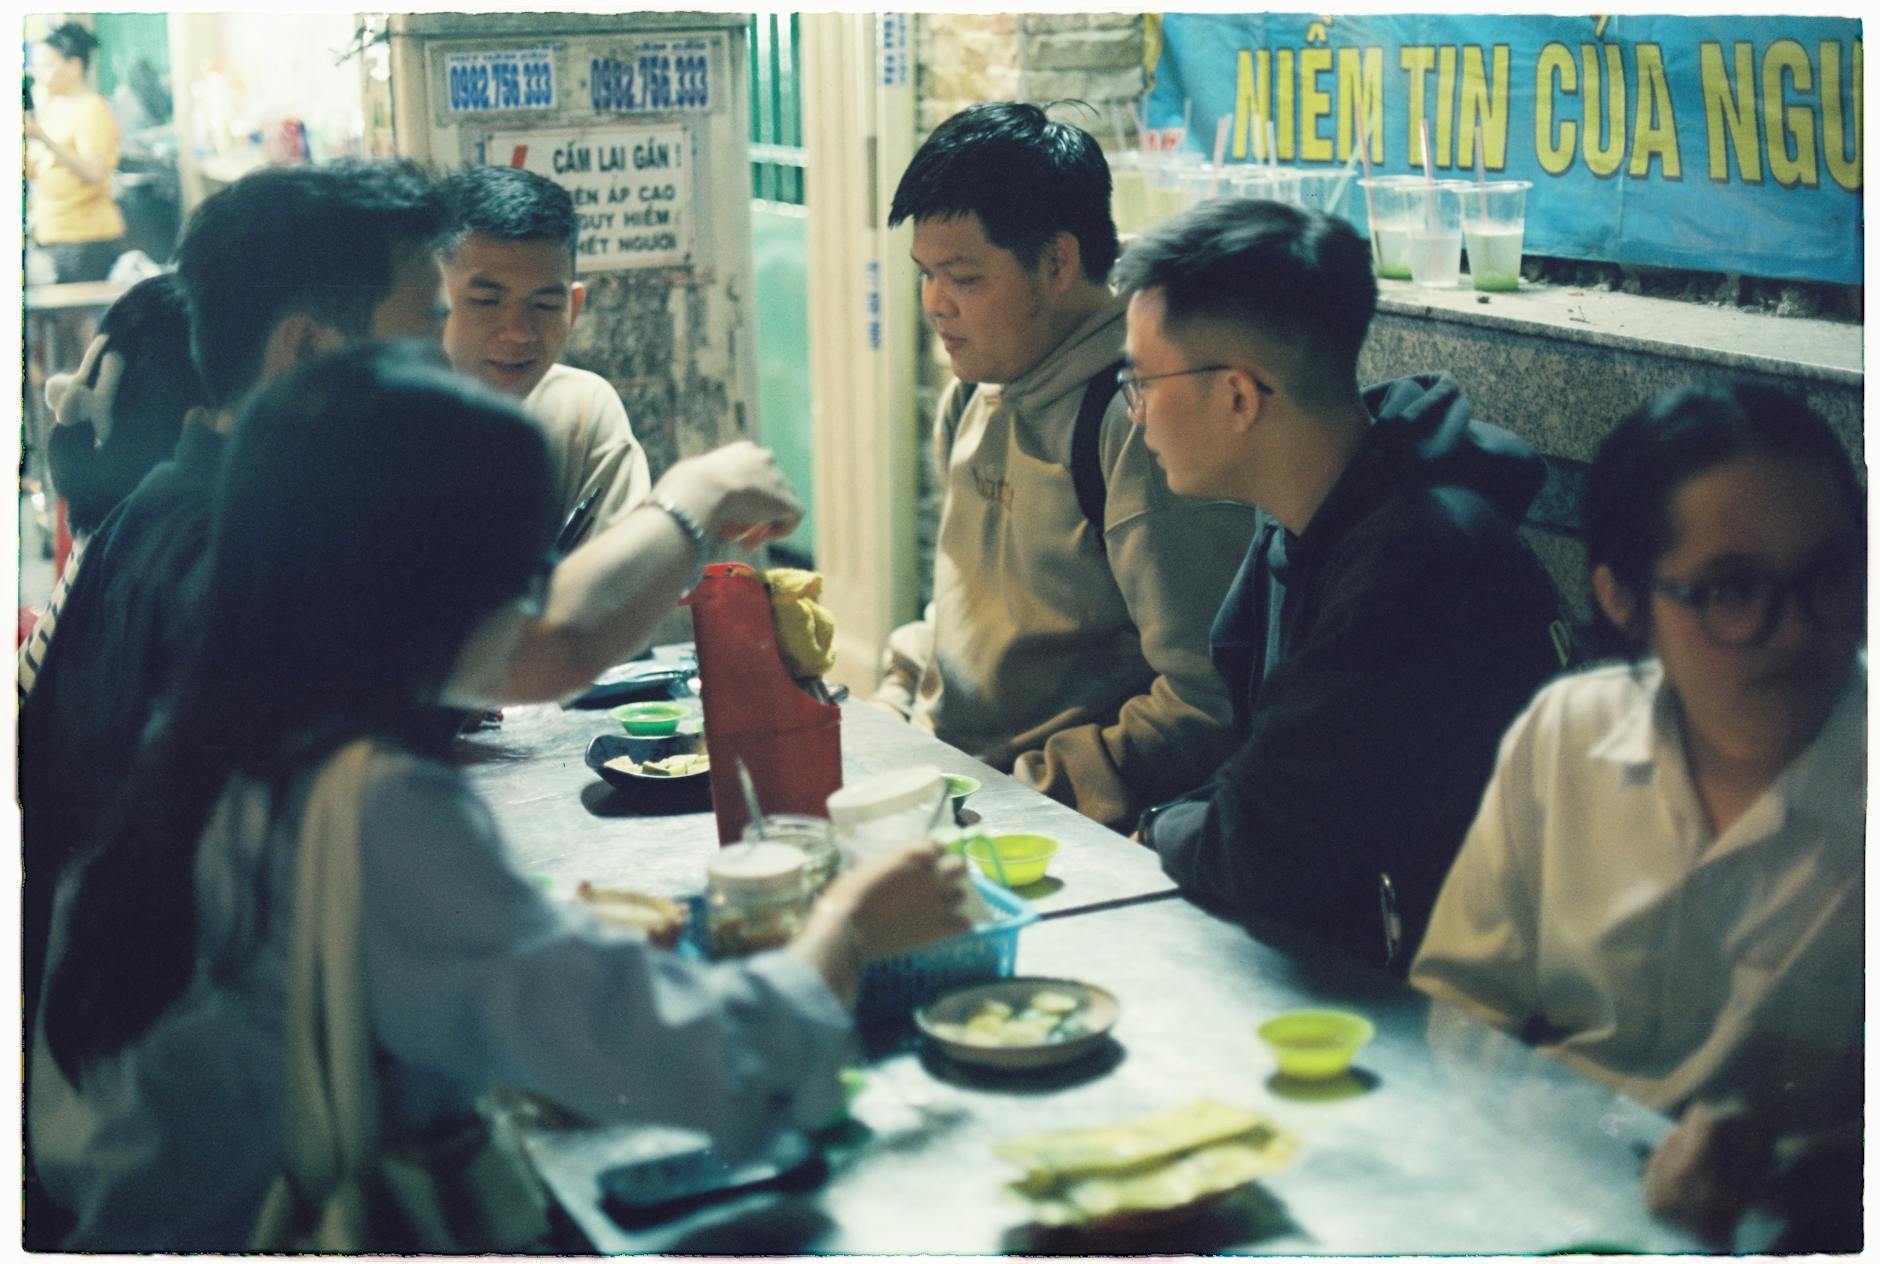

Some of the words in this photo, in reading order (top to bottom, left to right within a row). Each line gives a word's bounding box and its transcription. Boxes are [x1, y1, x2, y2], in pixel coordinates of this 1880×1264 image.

[1400, 43, 1511, 171] TIN
[1535, 15, 1682, 182] CỦA
[638, 184, 676, 202] CAO
